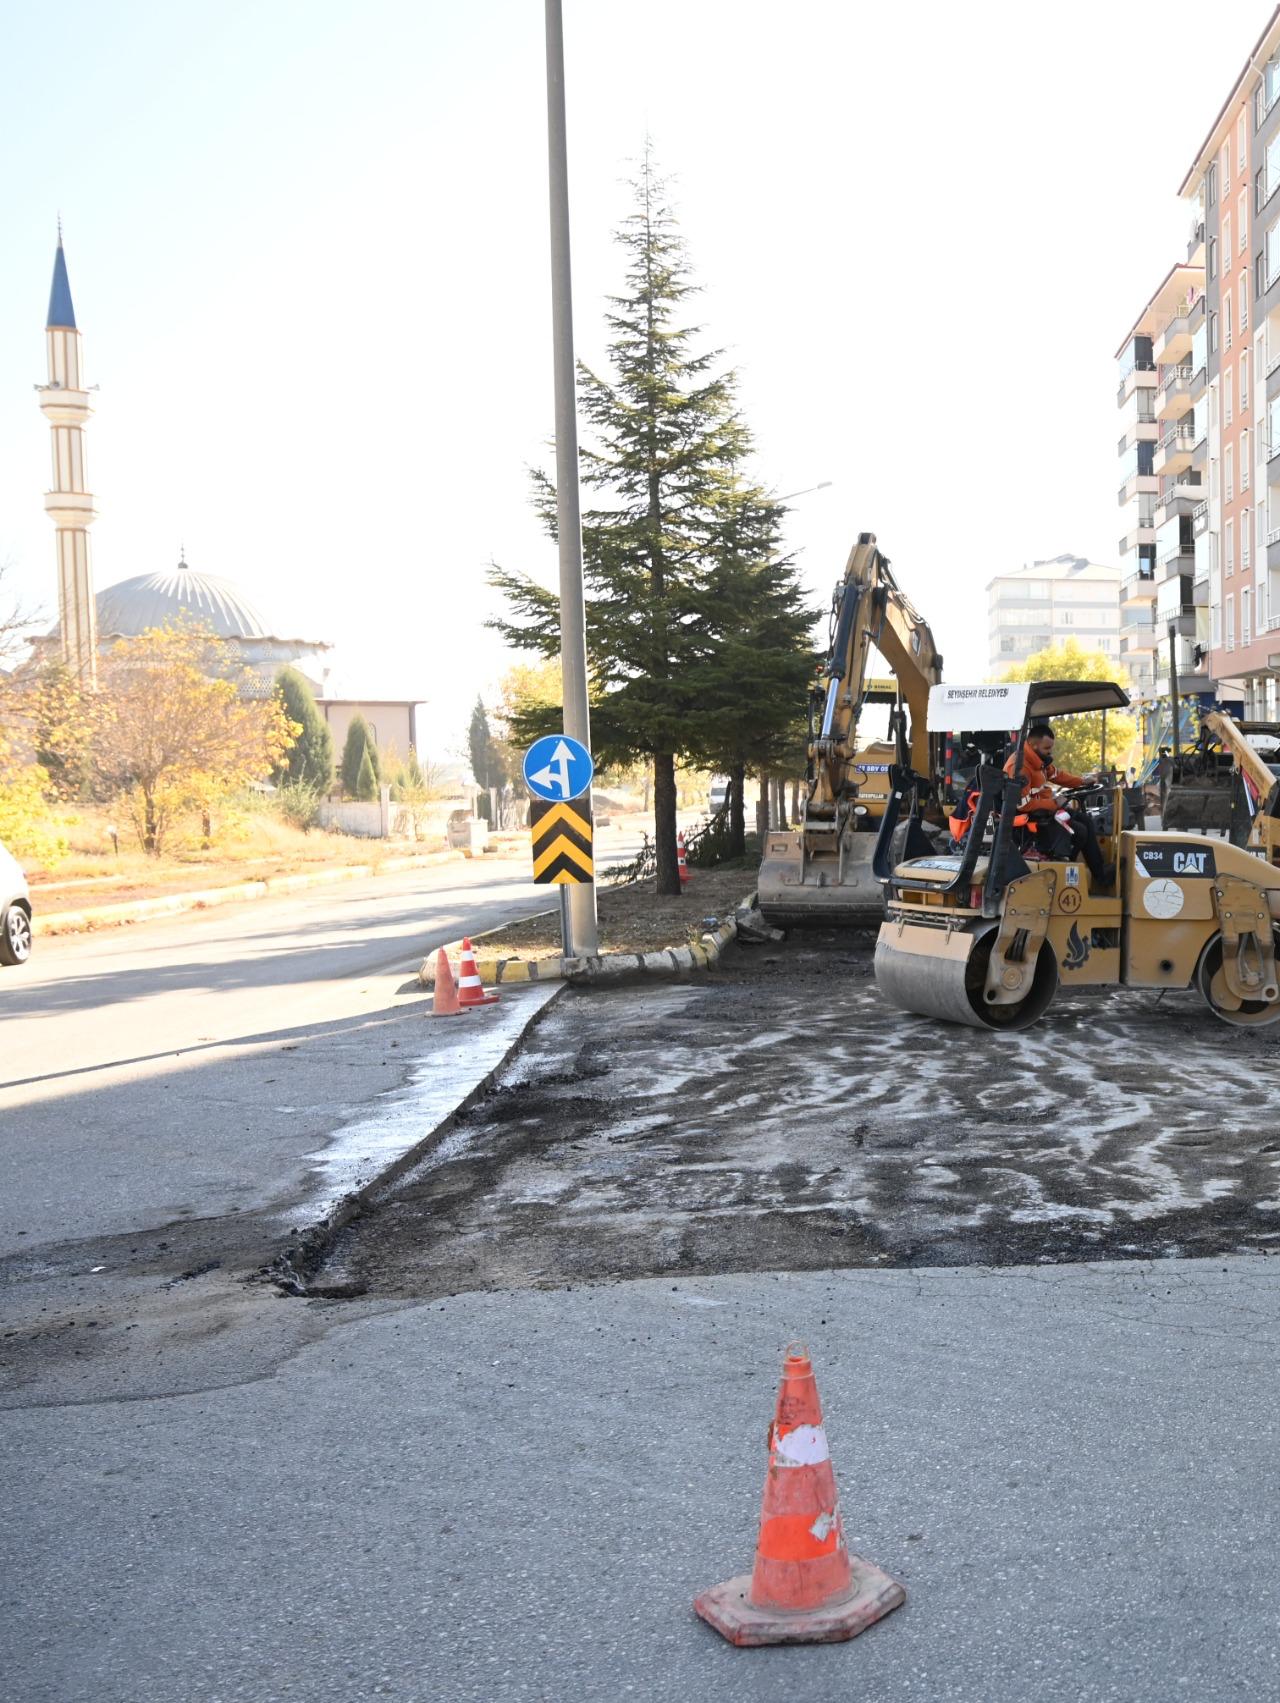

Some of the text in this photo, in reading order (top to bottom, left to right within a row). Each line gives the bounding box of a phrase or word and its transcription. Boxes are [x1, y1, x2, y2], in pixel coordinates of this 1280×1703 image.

[1143, 851, 1207, 873] CB34 CAT
[1062, 895, 1077, 907] 41
